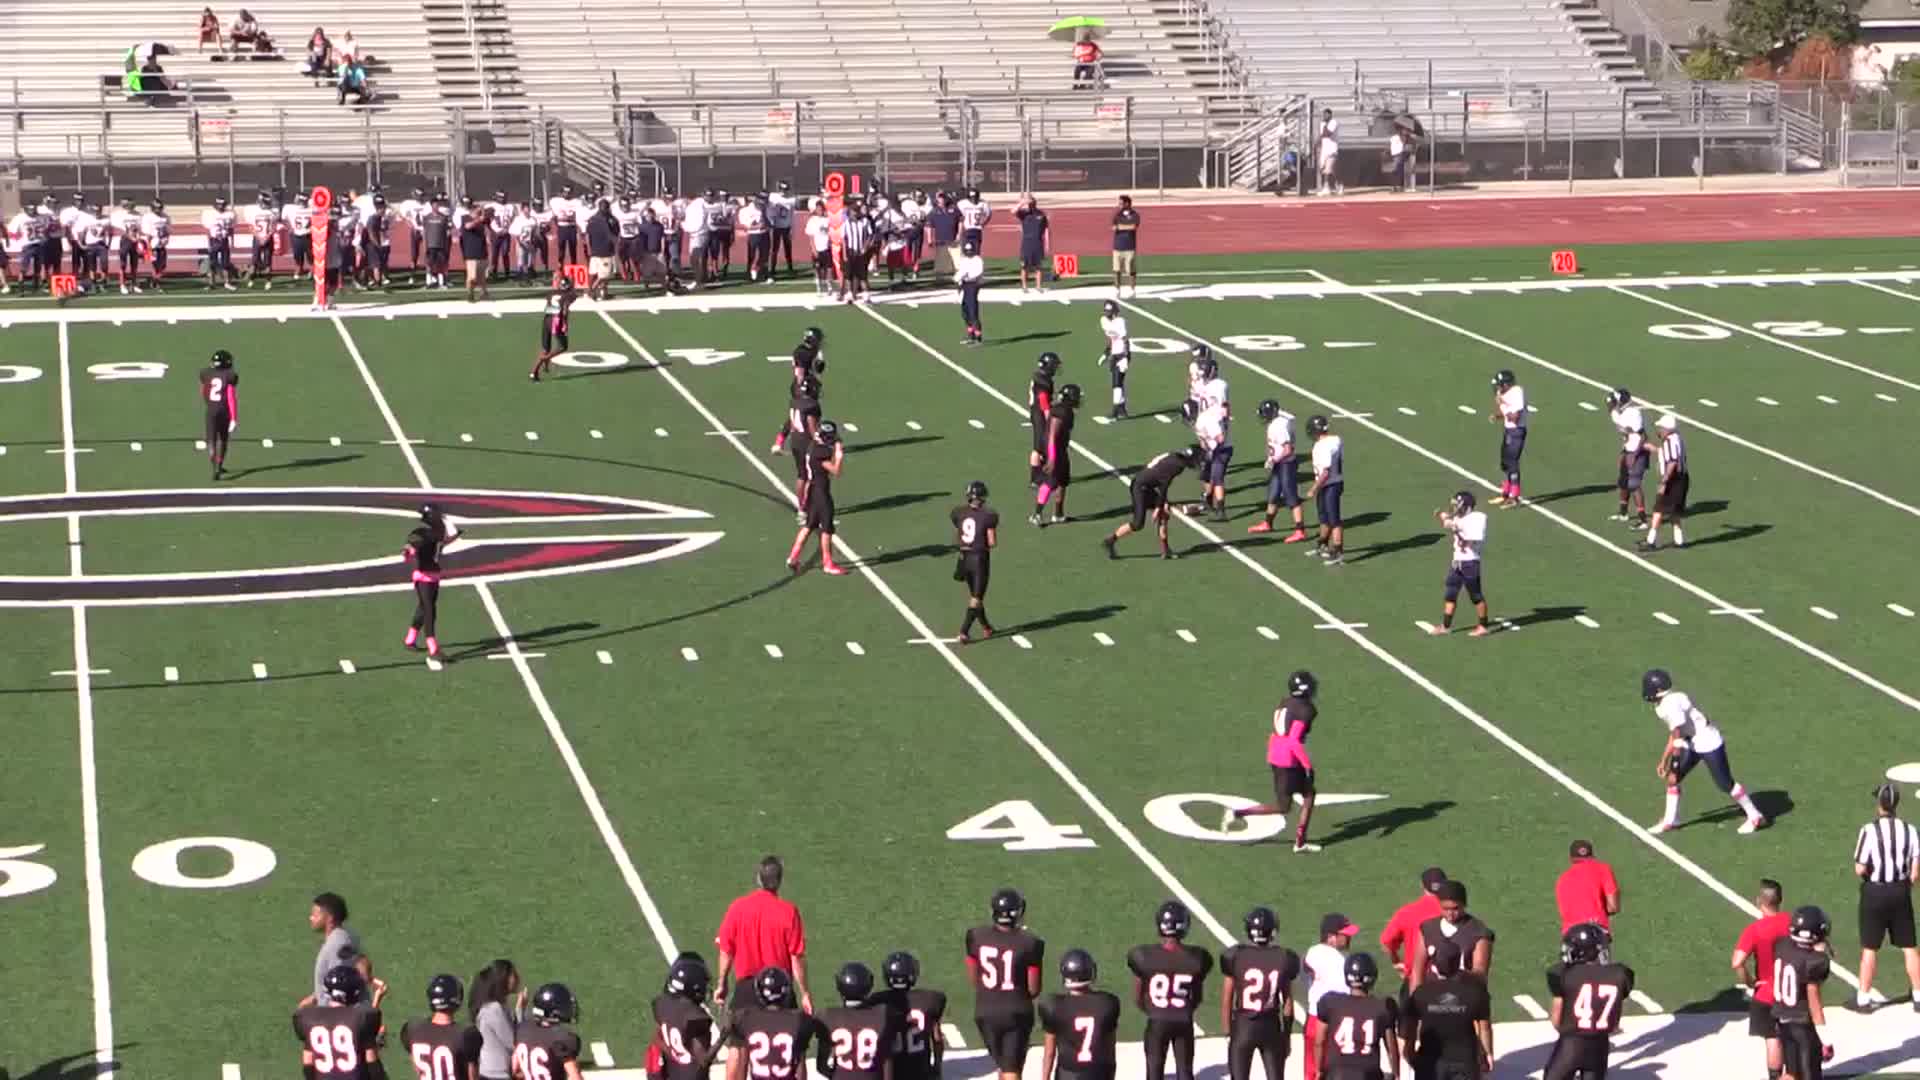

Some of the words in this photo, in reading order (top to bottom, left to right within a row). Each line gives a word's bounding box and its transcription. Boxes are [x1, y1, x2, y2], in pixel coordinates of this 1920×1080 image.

[1056, 257, 1074, 275] 30
[1555, 254, 1574, 273] 20
[209, 376, 224, 401] 2
[961, 517, 976, 544] 9
[979, 945, 1015, 991] 51
[1773, 958, 1798, 1007] 10
[1149, 973, 1194, 1009] 85
[1242, 968, 1281, 1012] 21
[1573, 983, 1619, 1030] 47
[309, 1025, 358, 1074] 99
[747, 1031, 794, 1078] 23
[830, 1027, 879, 1070] 28
[1074, 1016, 1096, 1063] 7
[1333, 1016, 1376, 1055] 41
[410, 1043, 457, 1080] 50
